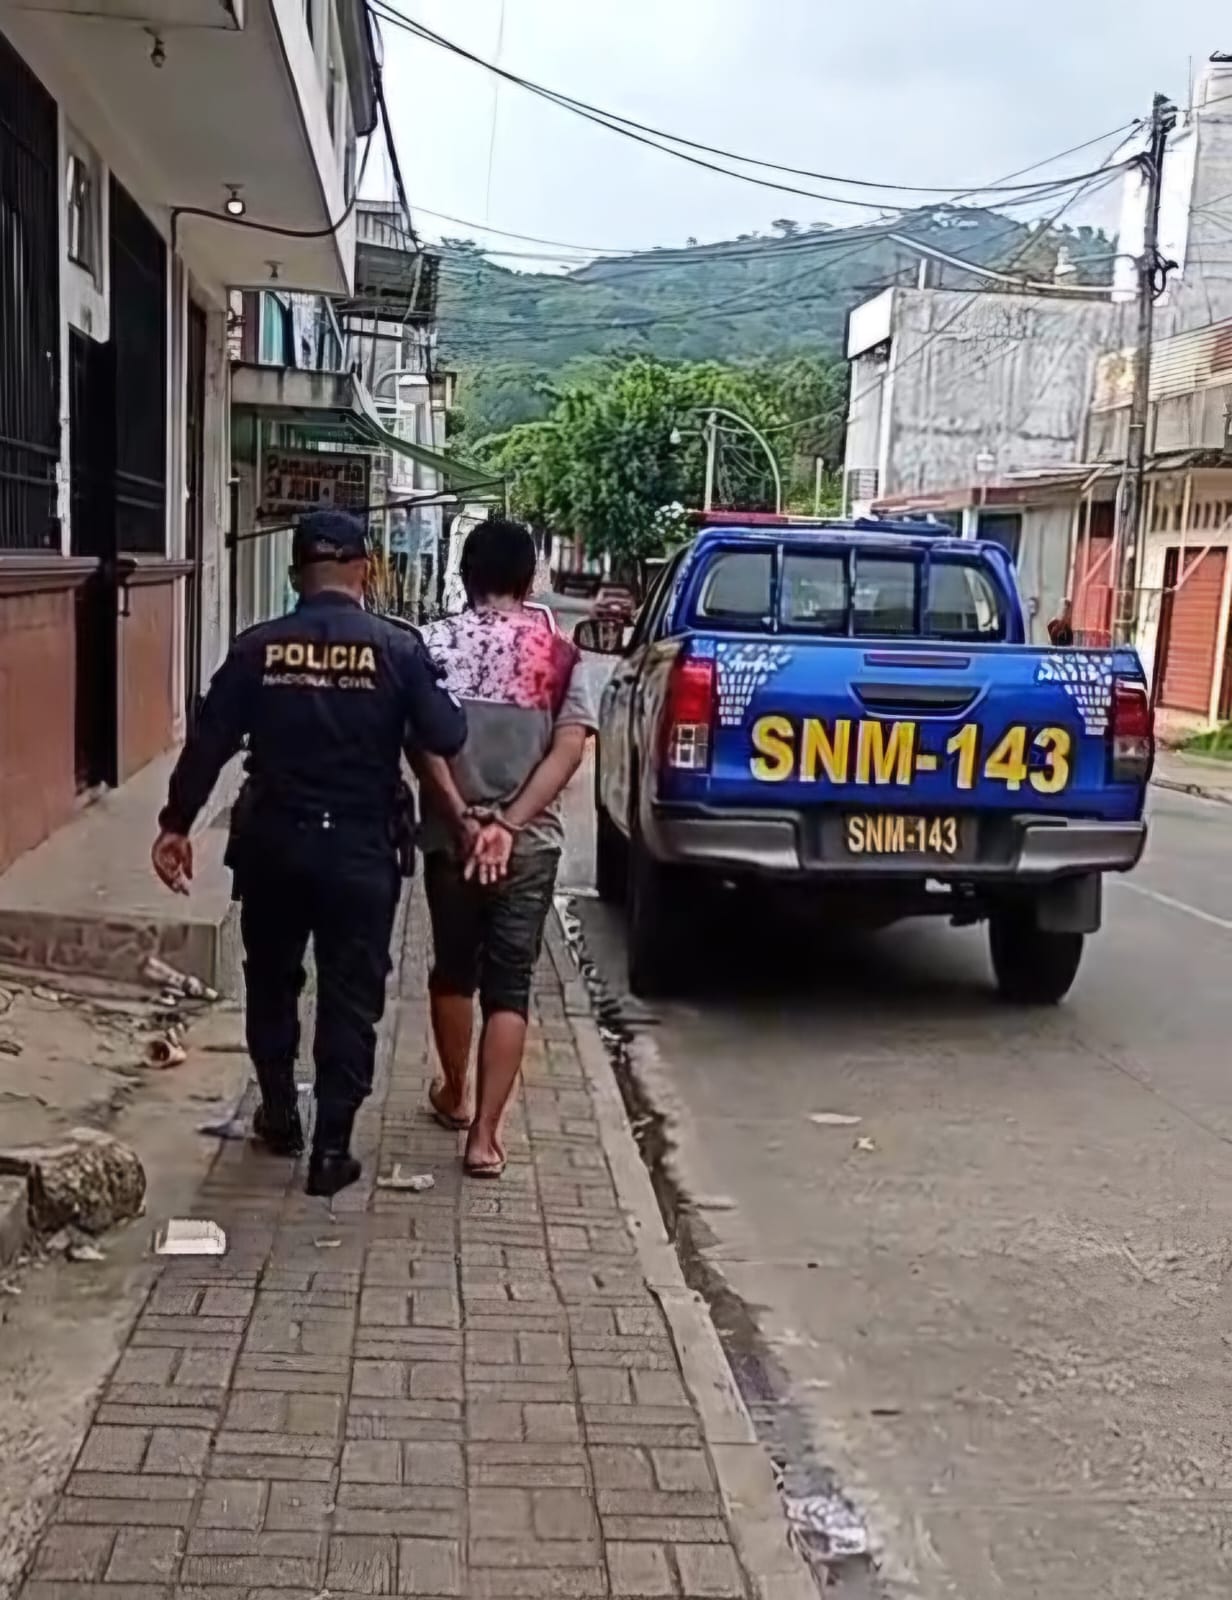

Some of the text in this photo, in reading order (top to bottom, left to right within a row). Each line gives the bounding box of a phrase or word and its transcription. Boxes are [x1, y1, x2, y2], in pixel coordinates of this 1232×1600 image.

[265, 643, 376, 671] POLICIA
[750, 715, 1072, 793] SNM-143
[848, 814, 957, 854] SNM-143
